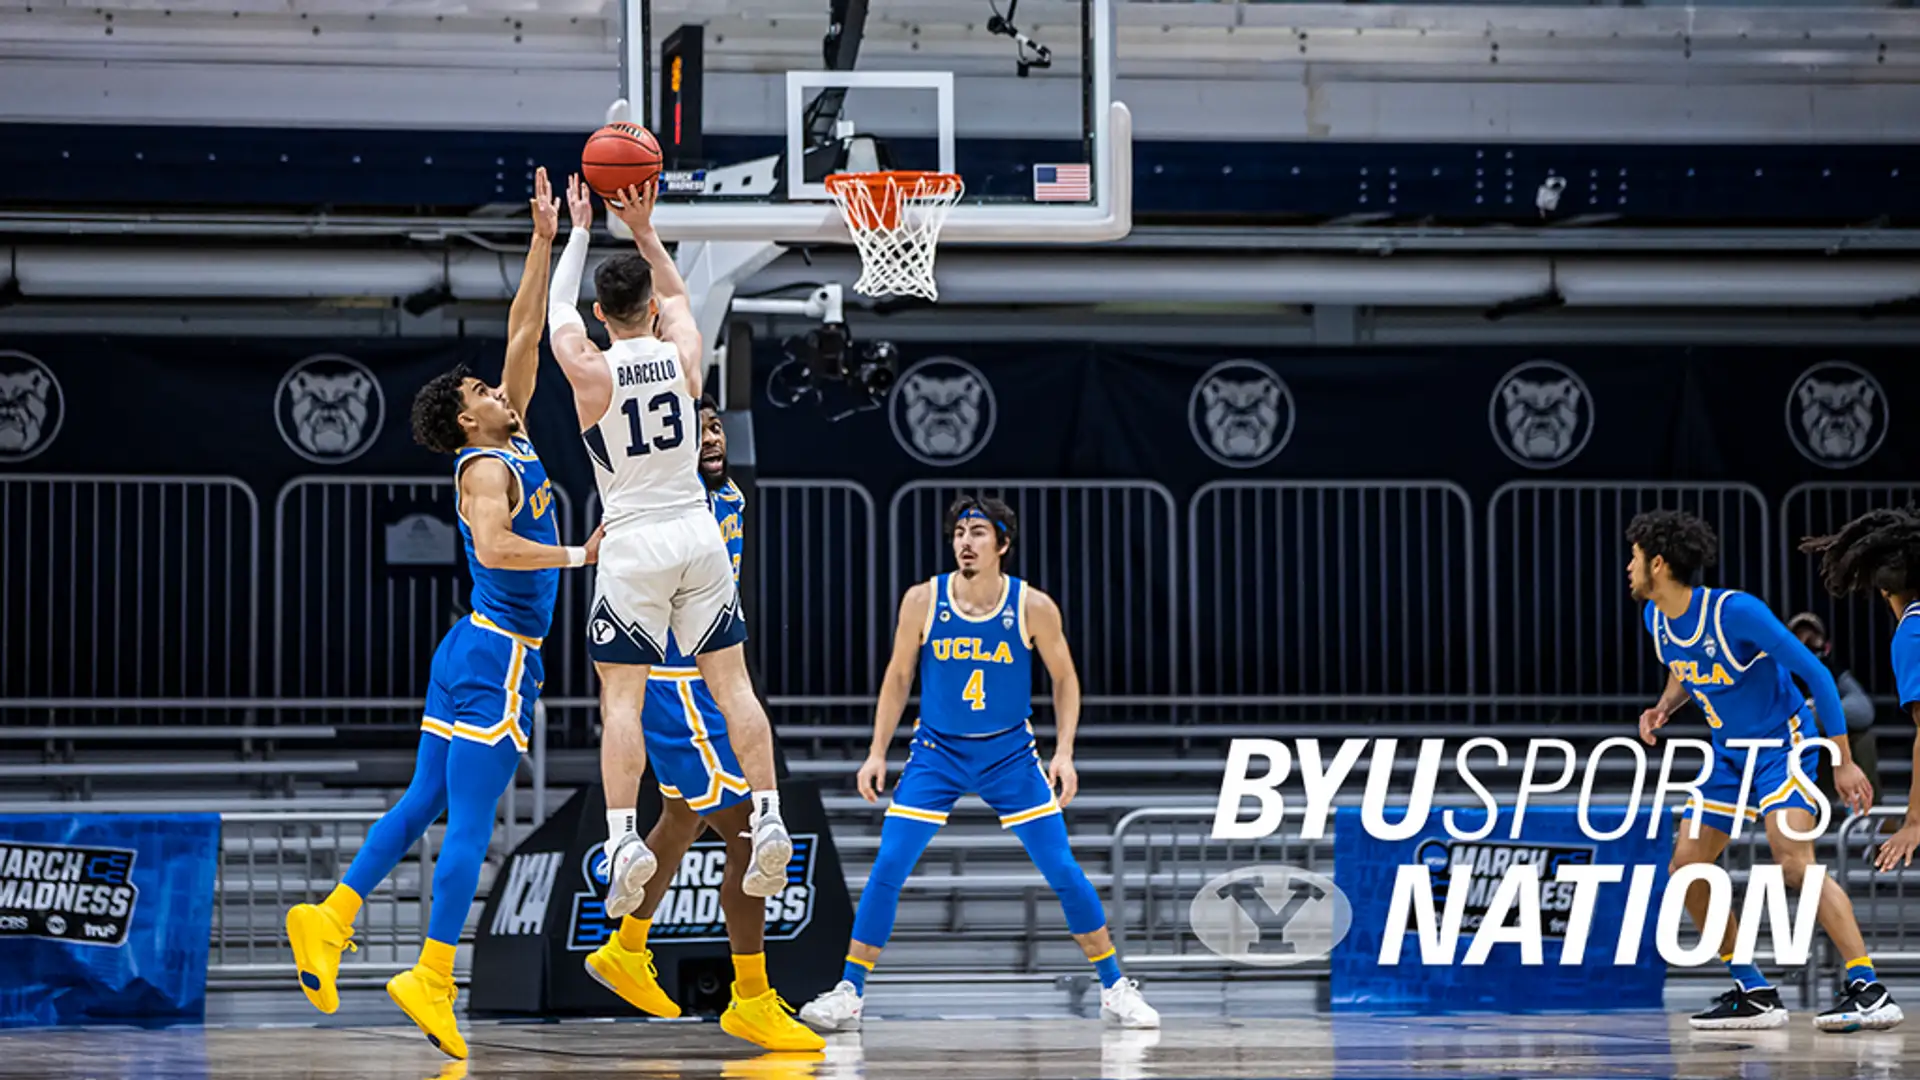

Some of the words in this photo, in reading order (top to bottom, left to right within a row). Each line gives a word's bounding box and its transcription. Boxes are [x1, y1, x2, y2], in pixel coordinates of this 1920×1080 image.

[617, 359, 677, 387] BARCELLO
[620, 391, 684, 457] 13
[932, 637, 1014, 664] UCLA
[962, 669, 986, 711] 4
[490, 851, 565, 935] NCAA
[652, 885, 808, 925] MADSS
